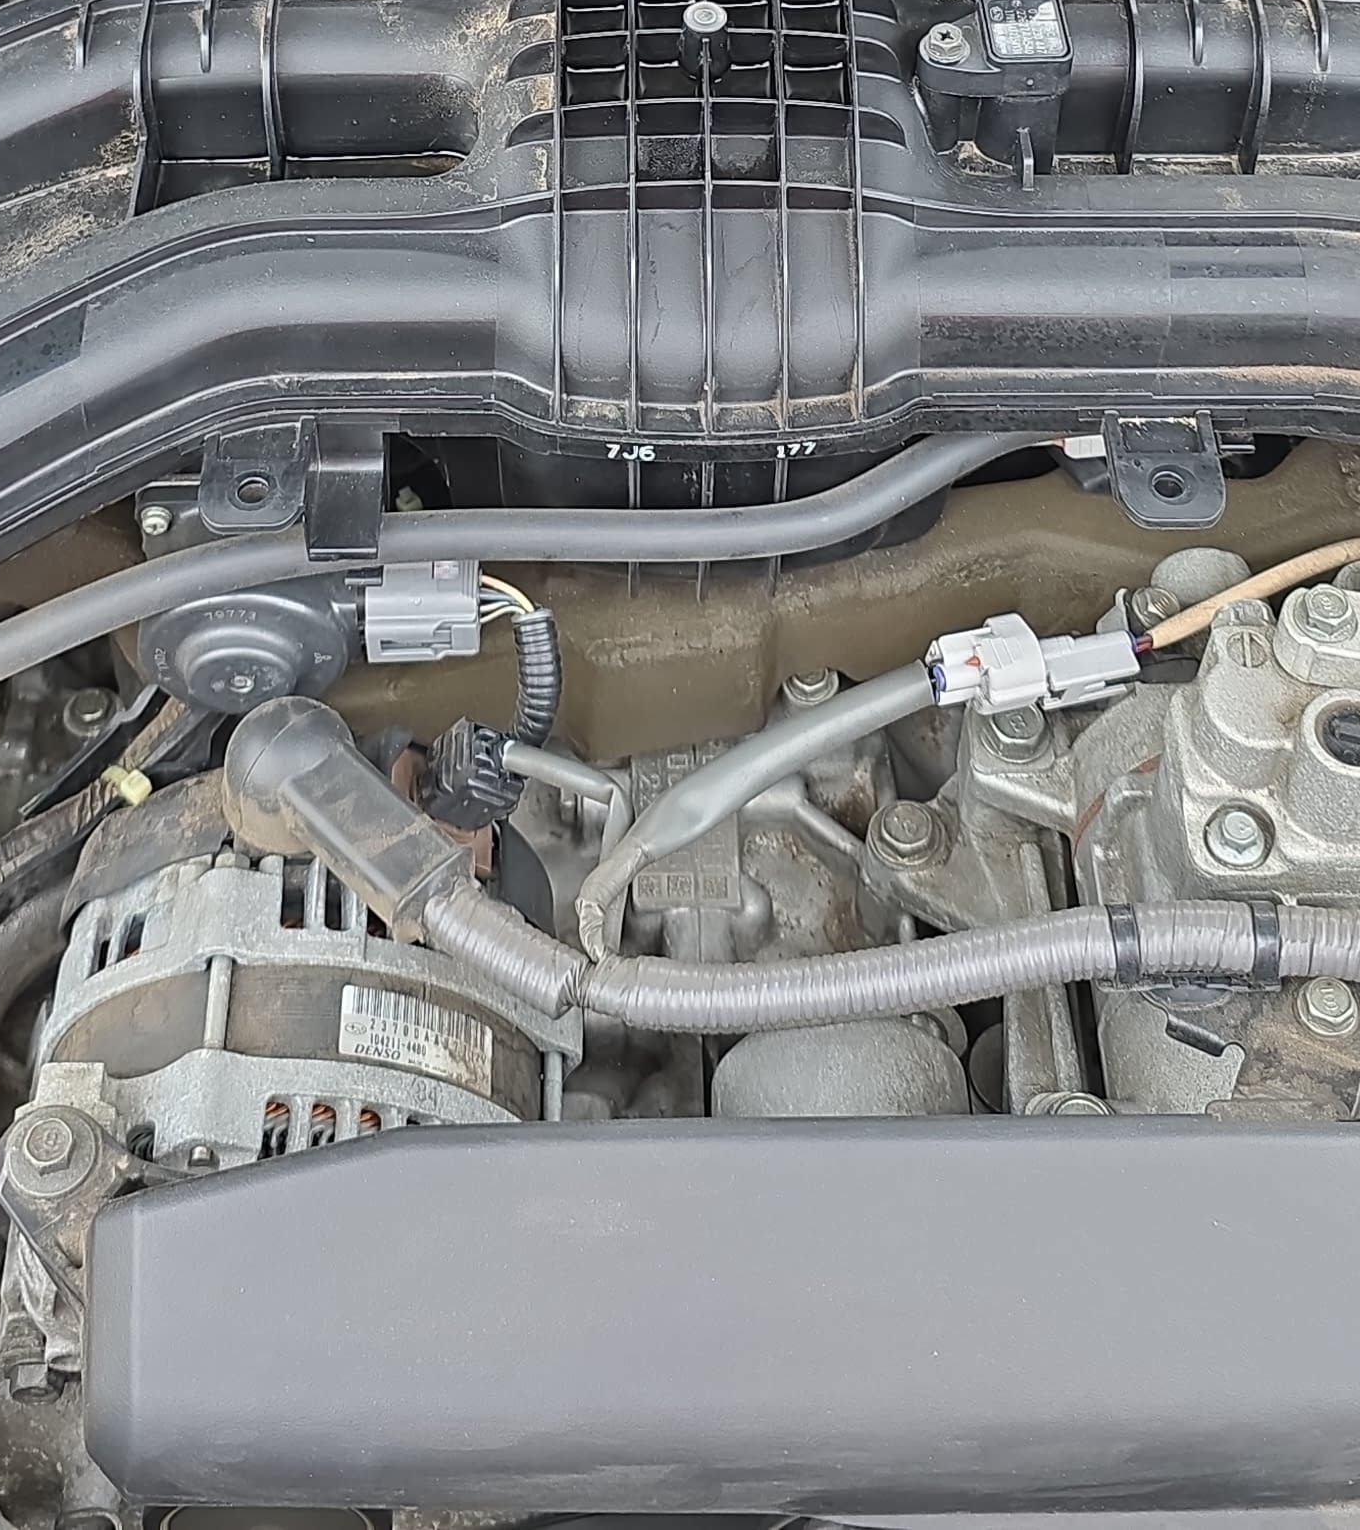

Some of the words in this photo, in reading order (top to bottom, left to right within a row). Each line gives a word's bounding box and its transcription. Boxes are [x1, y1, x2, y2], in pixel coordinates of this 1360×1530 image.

[605, 443, 656, 461] 7J6
[776, 441, 817, 459] 177
[354, 1043, 401, 1061] DENSO
